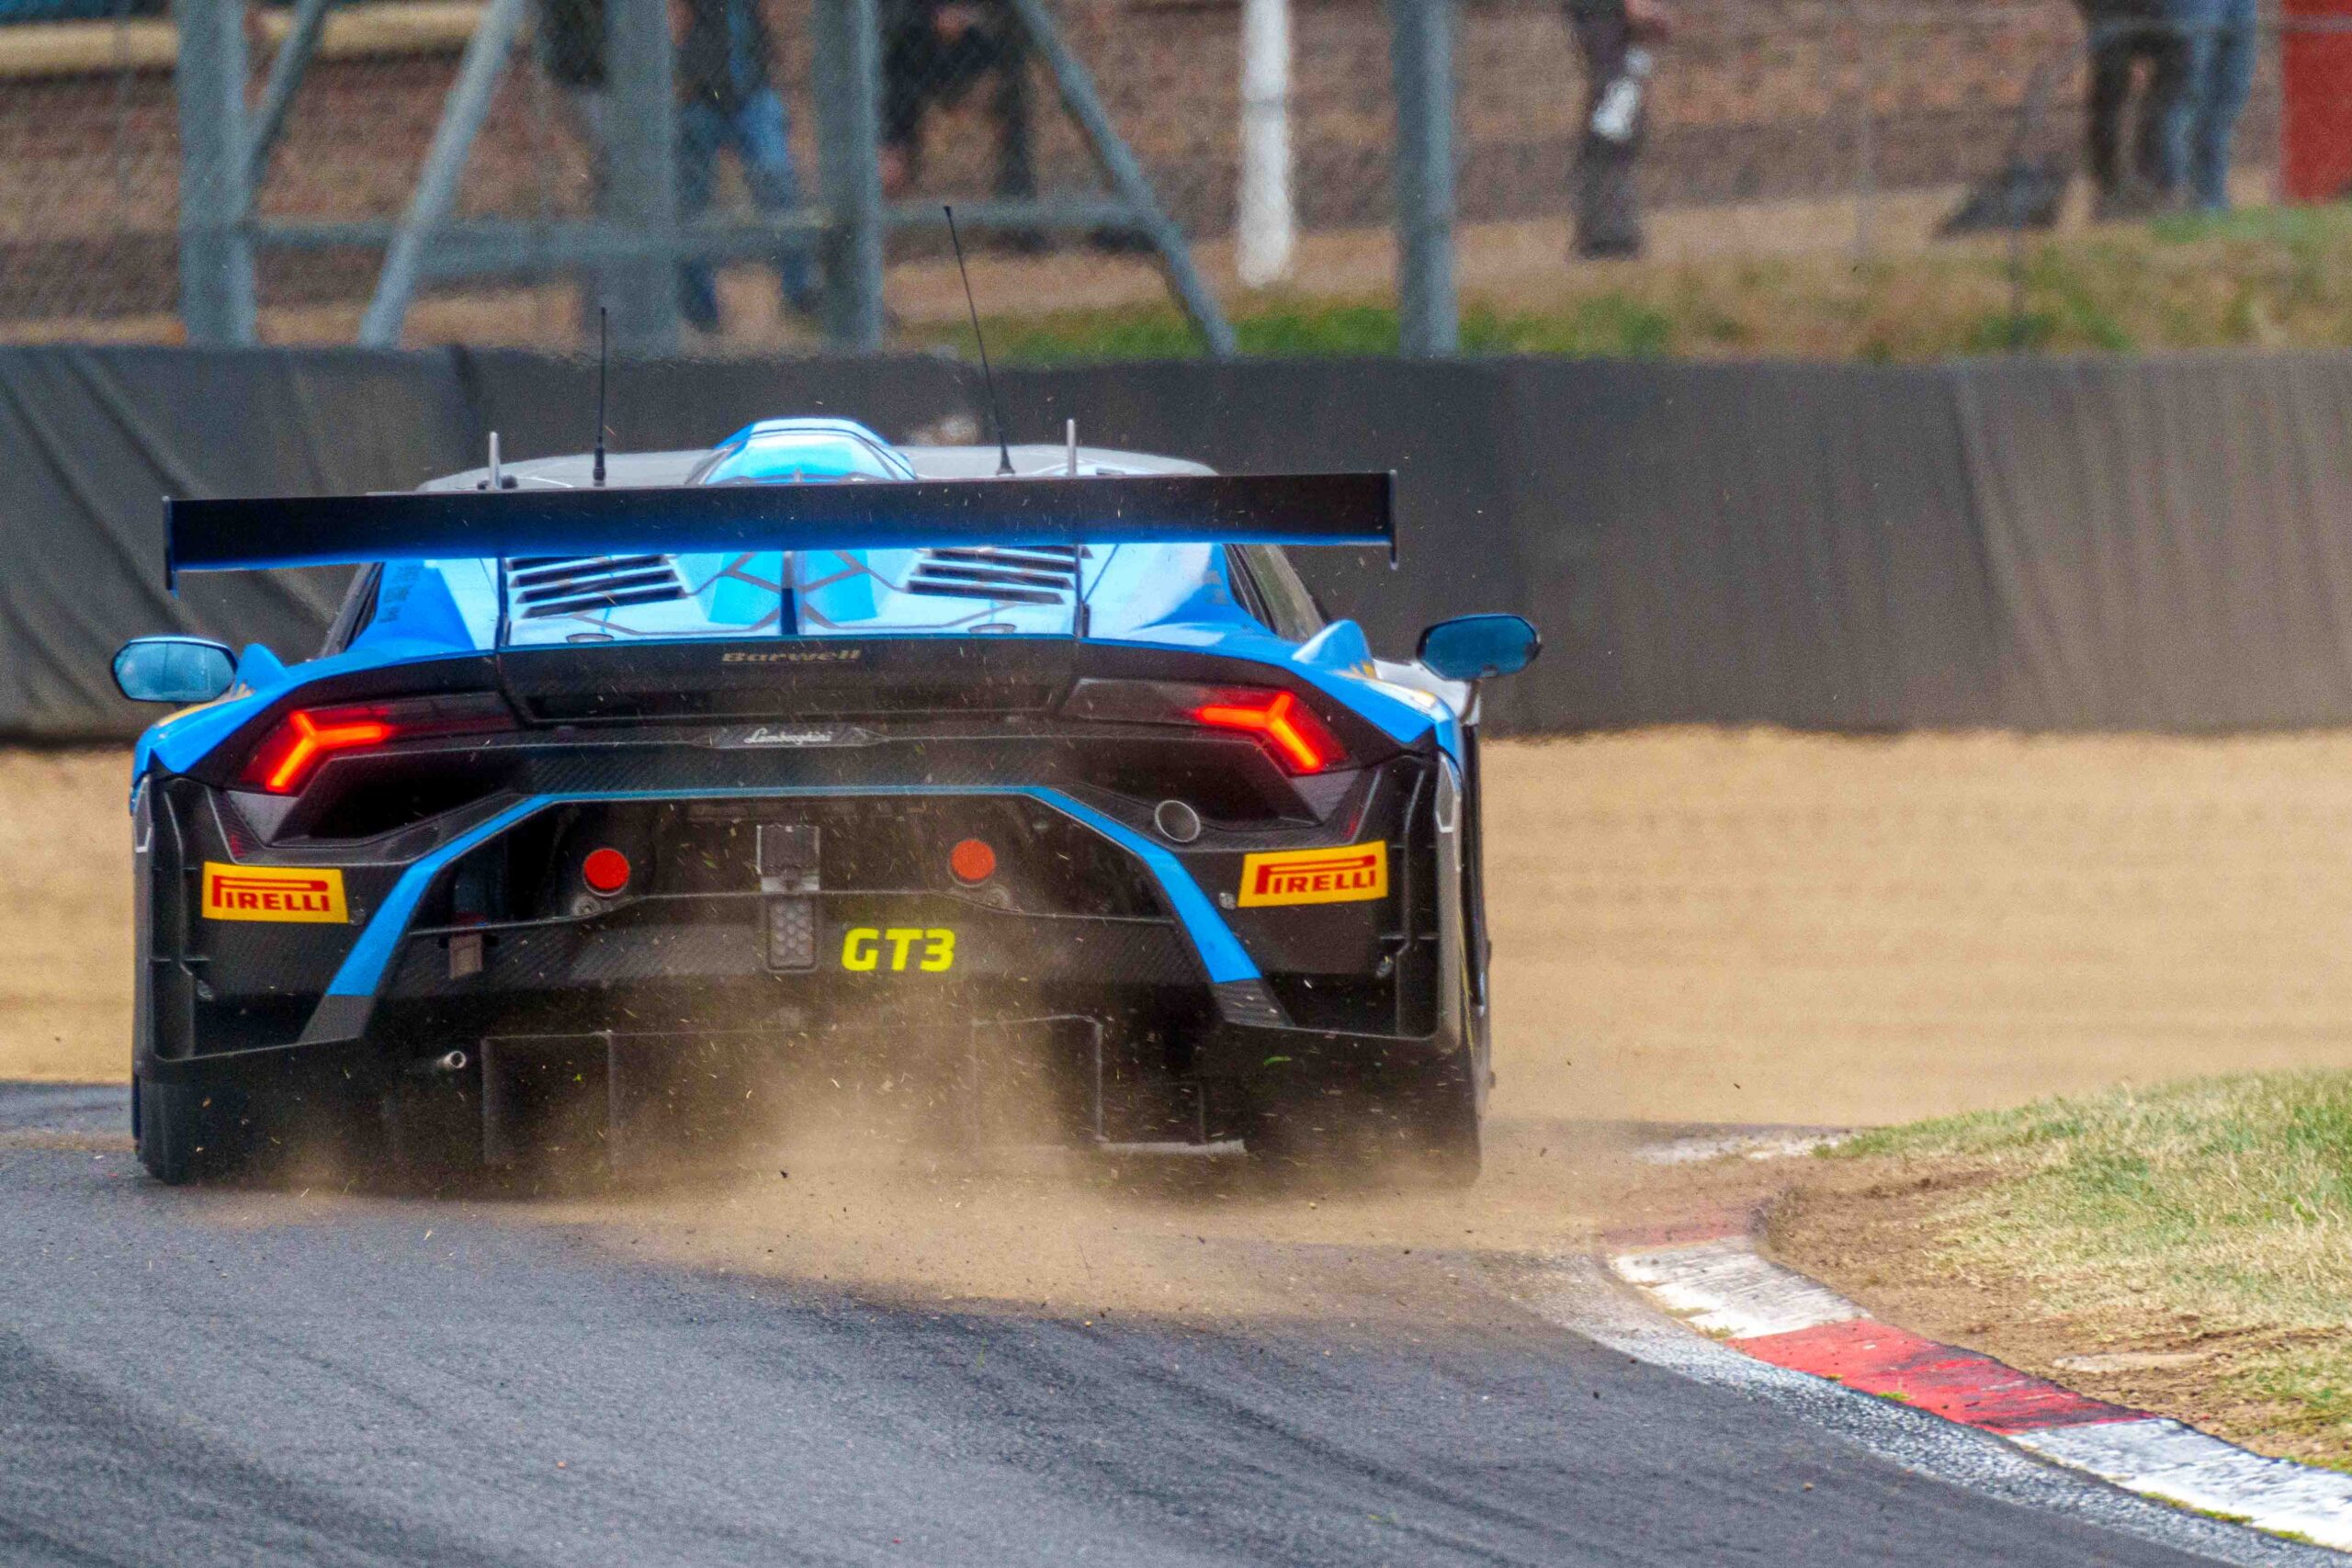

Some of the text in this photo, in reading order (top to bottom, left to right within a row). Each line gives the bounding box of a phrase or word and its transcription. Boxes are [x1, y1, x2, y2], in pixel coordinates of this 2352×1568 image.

[211, 874, 331, 912] PIRELLI
[1254, 854, 1376, 895] PIRELLI
[841, 928, 956, 971] GT3
